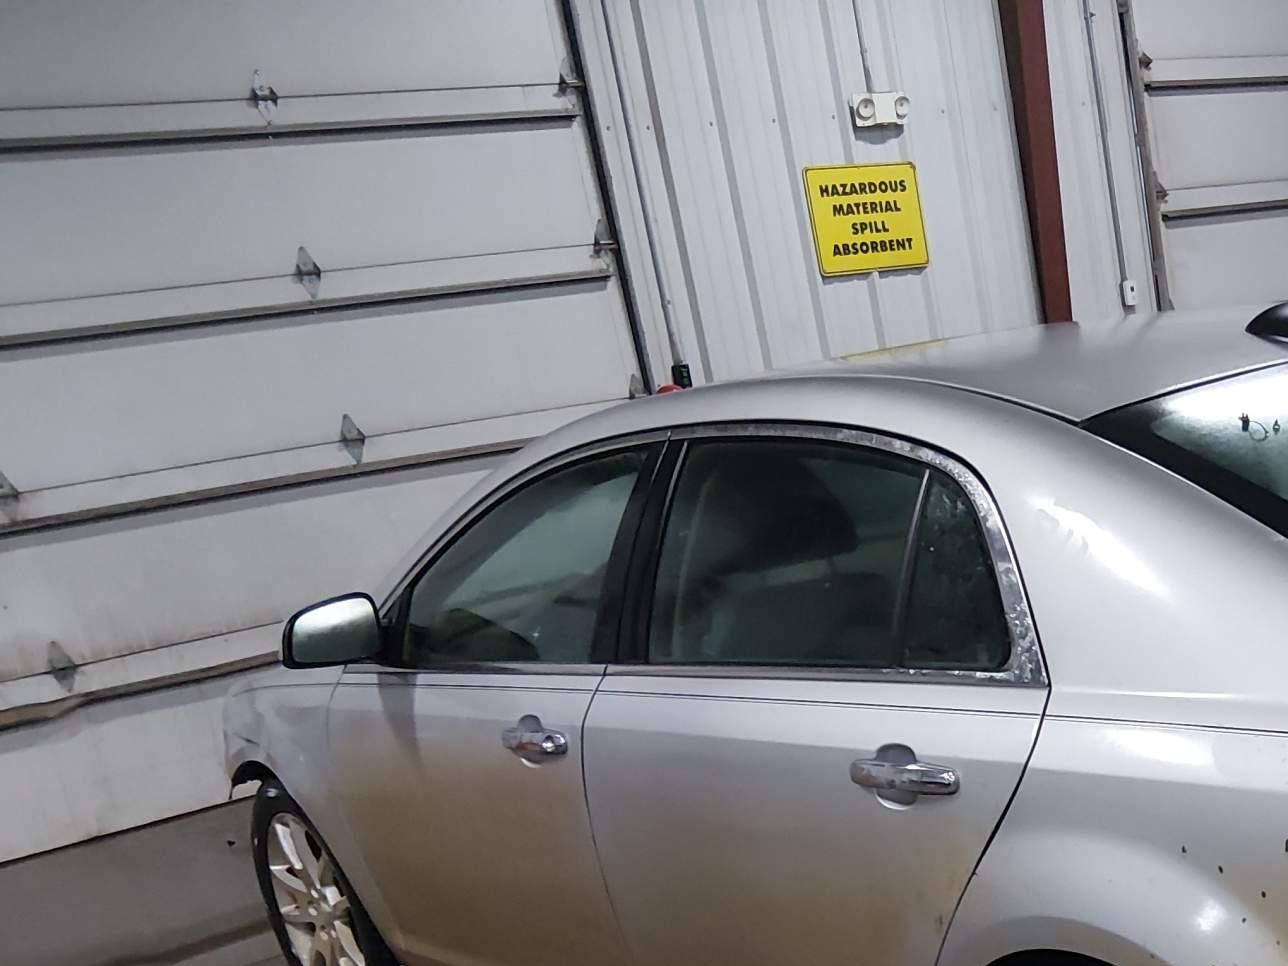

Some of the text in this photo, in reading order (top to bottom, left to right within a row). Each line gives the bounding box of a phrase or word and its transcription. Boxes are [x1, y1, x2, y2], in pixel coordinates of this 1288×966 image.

[819, 179, 907, 198] HAZARDOUS
[832, 200, 902, 217] MATERIAL
[851, 220, 890, 236] SPILL
[832, 238, 913, 257] ABSORBENT
